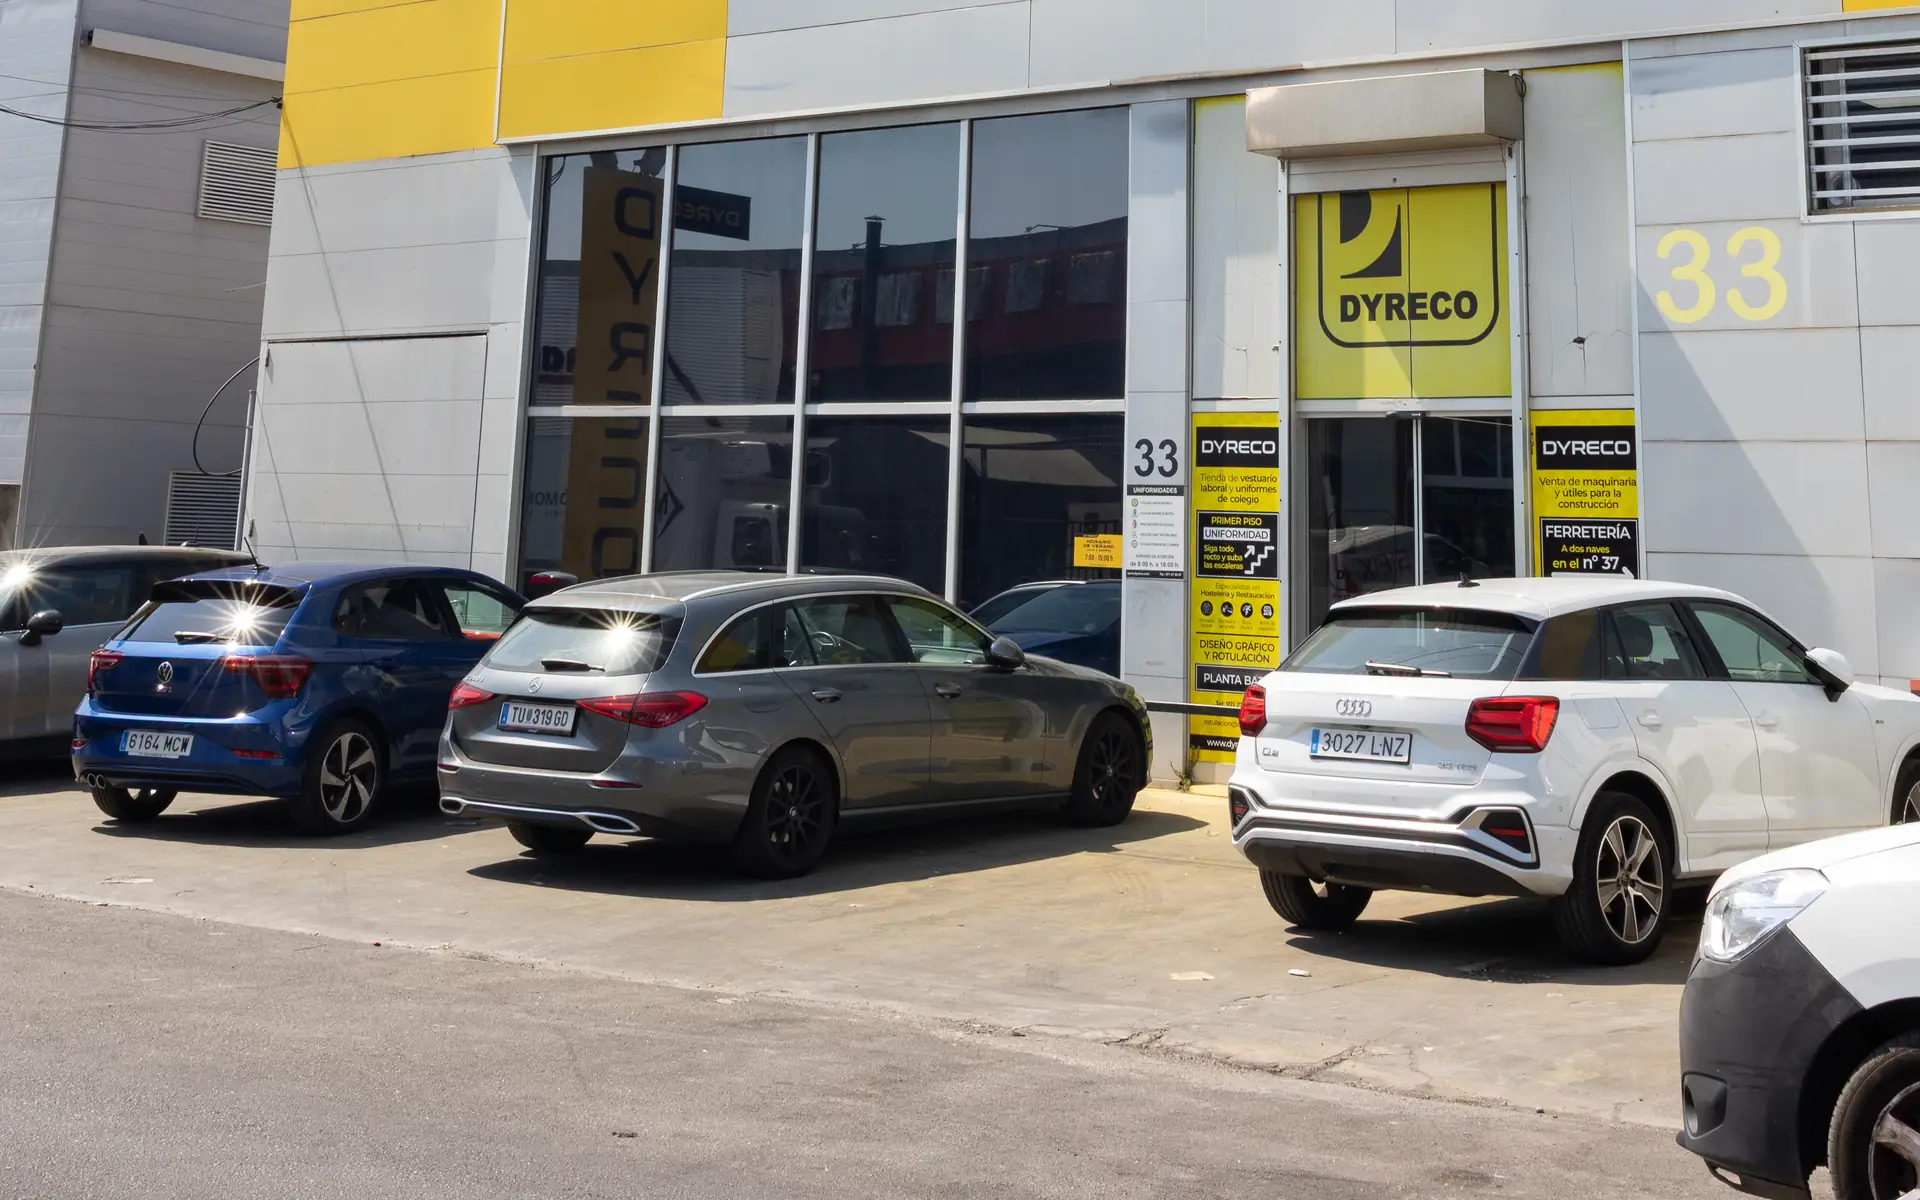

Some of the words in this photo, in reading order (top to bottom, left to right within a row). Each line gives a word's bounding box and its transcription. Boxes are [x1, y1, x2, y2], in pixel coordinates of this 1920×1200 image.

[1656, 226, 1787, 323] 33
[1340, 290, 1478, 322] DYRECO
[1201, 440, 1276, 454] DYRECO
[1543, 440, 1631, 455] DYRECO
[1133, 438, 1178, 477] 33
[1200, 473, 1226, 482] Tienda
[1228, 474, 1238, 482] de
[1240, 474, 1278, 483] vestuario
[1539, 477, 1566, 486] Venta
[1568, 477, 1580, 486] de
[1583, 478, 1637, 488] maquinaria
[1132, 486, 1178, 494] UNIFORMIDADES
[1200, 484, 1227, 492] laboral
[1236, 484, 1277, 493] uniformes
[1554, 490, 1560, 499] y
[1562, 487, 1587, 497] útiles
[1590, 490, 1611, 500] para
[1613, 489, 1622, 498] la
[1217, 494, 1228, 503] de
[1230, 495, 1260, 505] colegio
[1558, 499, 1619, 509] construcción
[1211, 516, 1242, 525] PRIMER
[1243, 517, 1262, 526] PISO
[1205, 529, 1269, 539] UNIFORMIDAD
[1545, 523, 1631, 540] FERRETERÍA
[1204, 544, 1218, 553] Siga
[1219, 545, 1235, 553] todo
[1561, 545, 1568, 553] A
[1569, 545, 1584, 553] dos
[1586, 546, 1610, 554] naves
[1214, 562, 1244, 570] escaleras
[1552, 560, 1566, 569] en
[1569, 558, 1579, 569] el
[1601, 556, 1620, 570] 37
[1215, 582, 1251, 591] Especialistas
[1236, 591, 1275, 600] Restauración
[1200, 638, 1233, 650] DISEÑO
[1235, 640, 1275, 652] GRÁFICO
[1204, 651, 1210, 660] Y
[1212, 651, 1270, 663] ROTULACIÓN
[1203, 673, 1242, 685] PLANTA
[1244, 675, 1263, 686] BA
[512, 707, 526, 723] TU
[532, 708, 553, 725] 319
[553, 710, 569, 727] GD
[128, 733, 160, 750] 6164
[163, 736, 190, 753] MCW
[1322, 733, 1366, 753] 3027
[1371, 736, 1405, 757] LNZ
